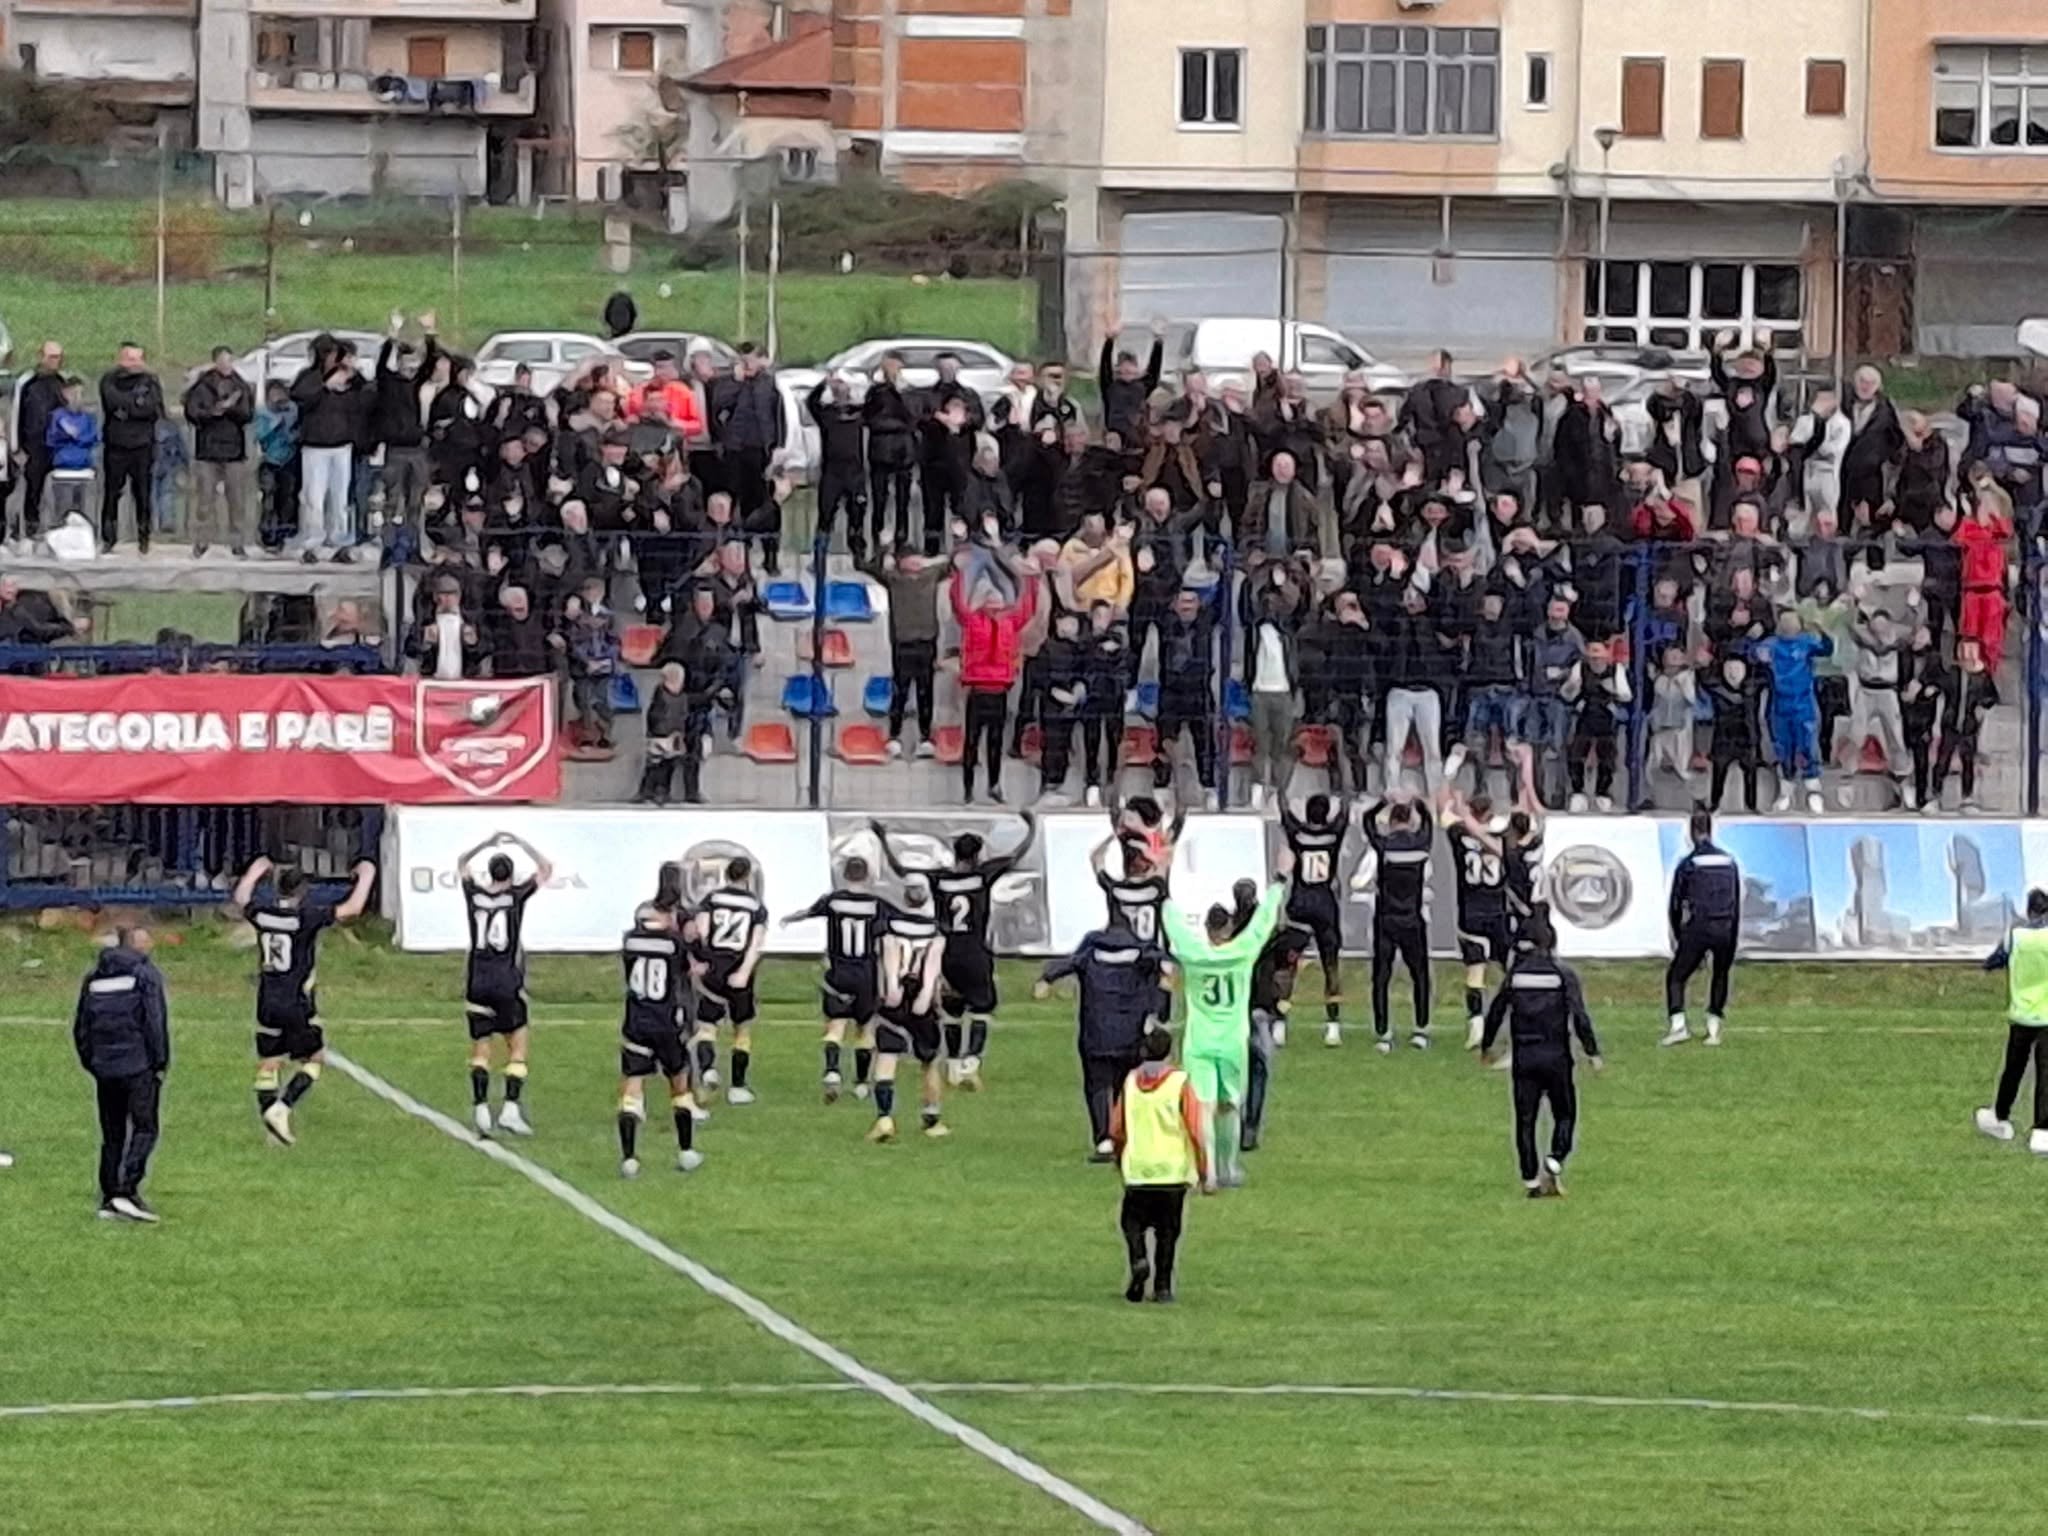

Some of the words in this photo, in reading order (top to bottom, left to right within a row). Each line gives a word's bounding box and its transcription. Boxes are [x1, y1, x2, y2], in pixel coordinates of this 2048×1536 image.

[239, 711, 268, 749] E
[473, 909, 508, 952] 14
[950, 895, 970, 932] 2
[841, 917, 865, 957] 11
[1202, 972, 1234, 1008] 31
